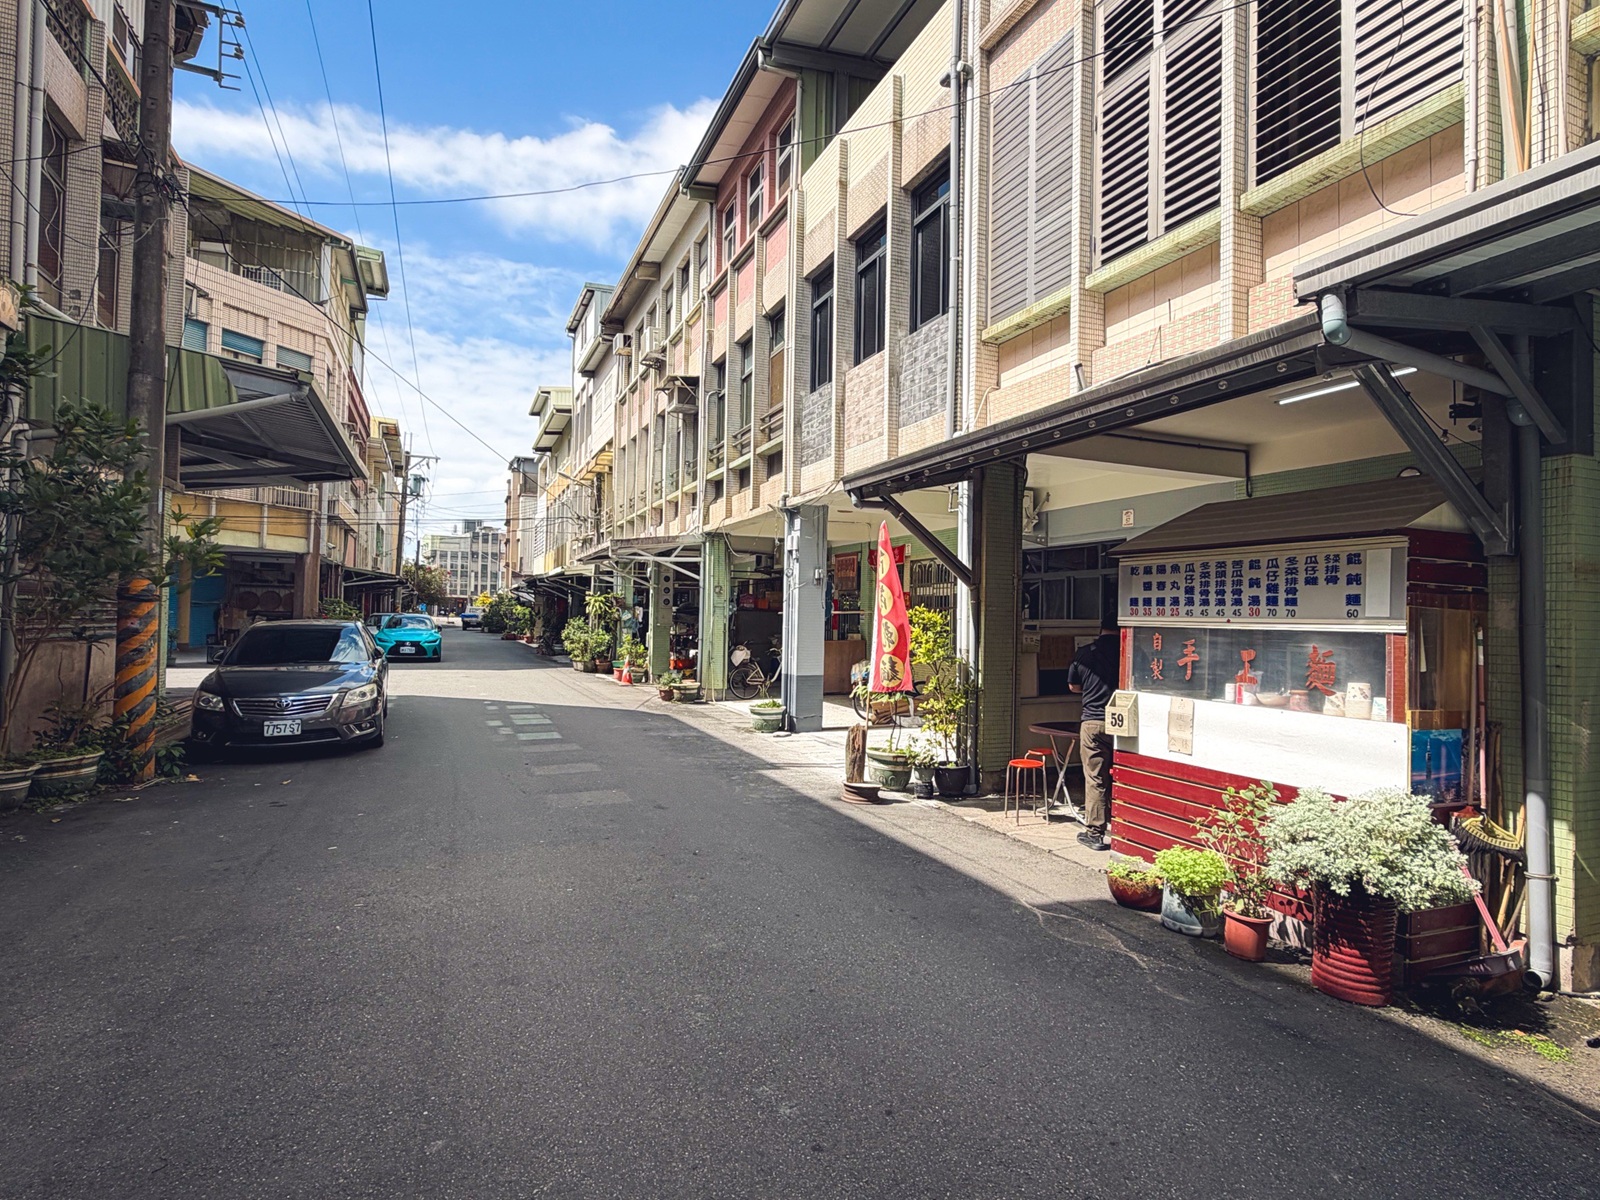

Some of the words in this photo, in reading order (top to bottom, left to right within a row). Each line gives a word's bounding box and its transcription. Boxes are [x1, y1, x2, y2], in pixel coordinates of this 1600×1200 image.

[1130, 567, 1139, 606] 乾麵
[1156, 565, 1166, 606] 陽春麵
[1170, 564, 1180, 606] 魚丸湯
[1184, 563, 1195, 606] 瓜仔雞湯
[1199, 562, 1211, 606] 冬菜排骨湯
[1215, 561, 1227, 606] 菜頭排骨湯
[1231, 560, 1244, 606] 苦瓜排骨湯
[1248, 559, 1261, 606] 餛飩湯
[1266, 558, 1279, 606] 瓜仔雞麵
[1284, 556, 1299, 606] 冬菜排骨麵
[1304, 555, 1319, 586] 瓜仔雞
[1345, 553, 1362, 606] 餛飩麵
[1130, 608, 1138, 616] 30
[1143, 608, 1152, 616] 35
[1156, 608, 1165, 616] 30
[1170, 608, 1180, 616] 25
[1185, 609, 1193, 617] 45
[1249, 607, 1260, 617] 30
[1286, 609, 1296, 617] 70
[1347, 609, 1358, 618] 60
[1150, 632, 1164, 680] 自製
[1111, 713, 1124, 727] 59
